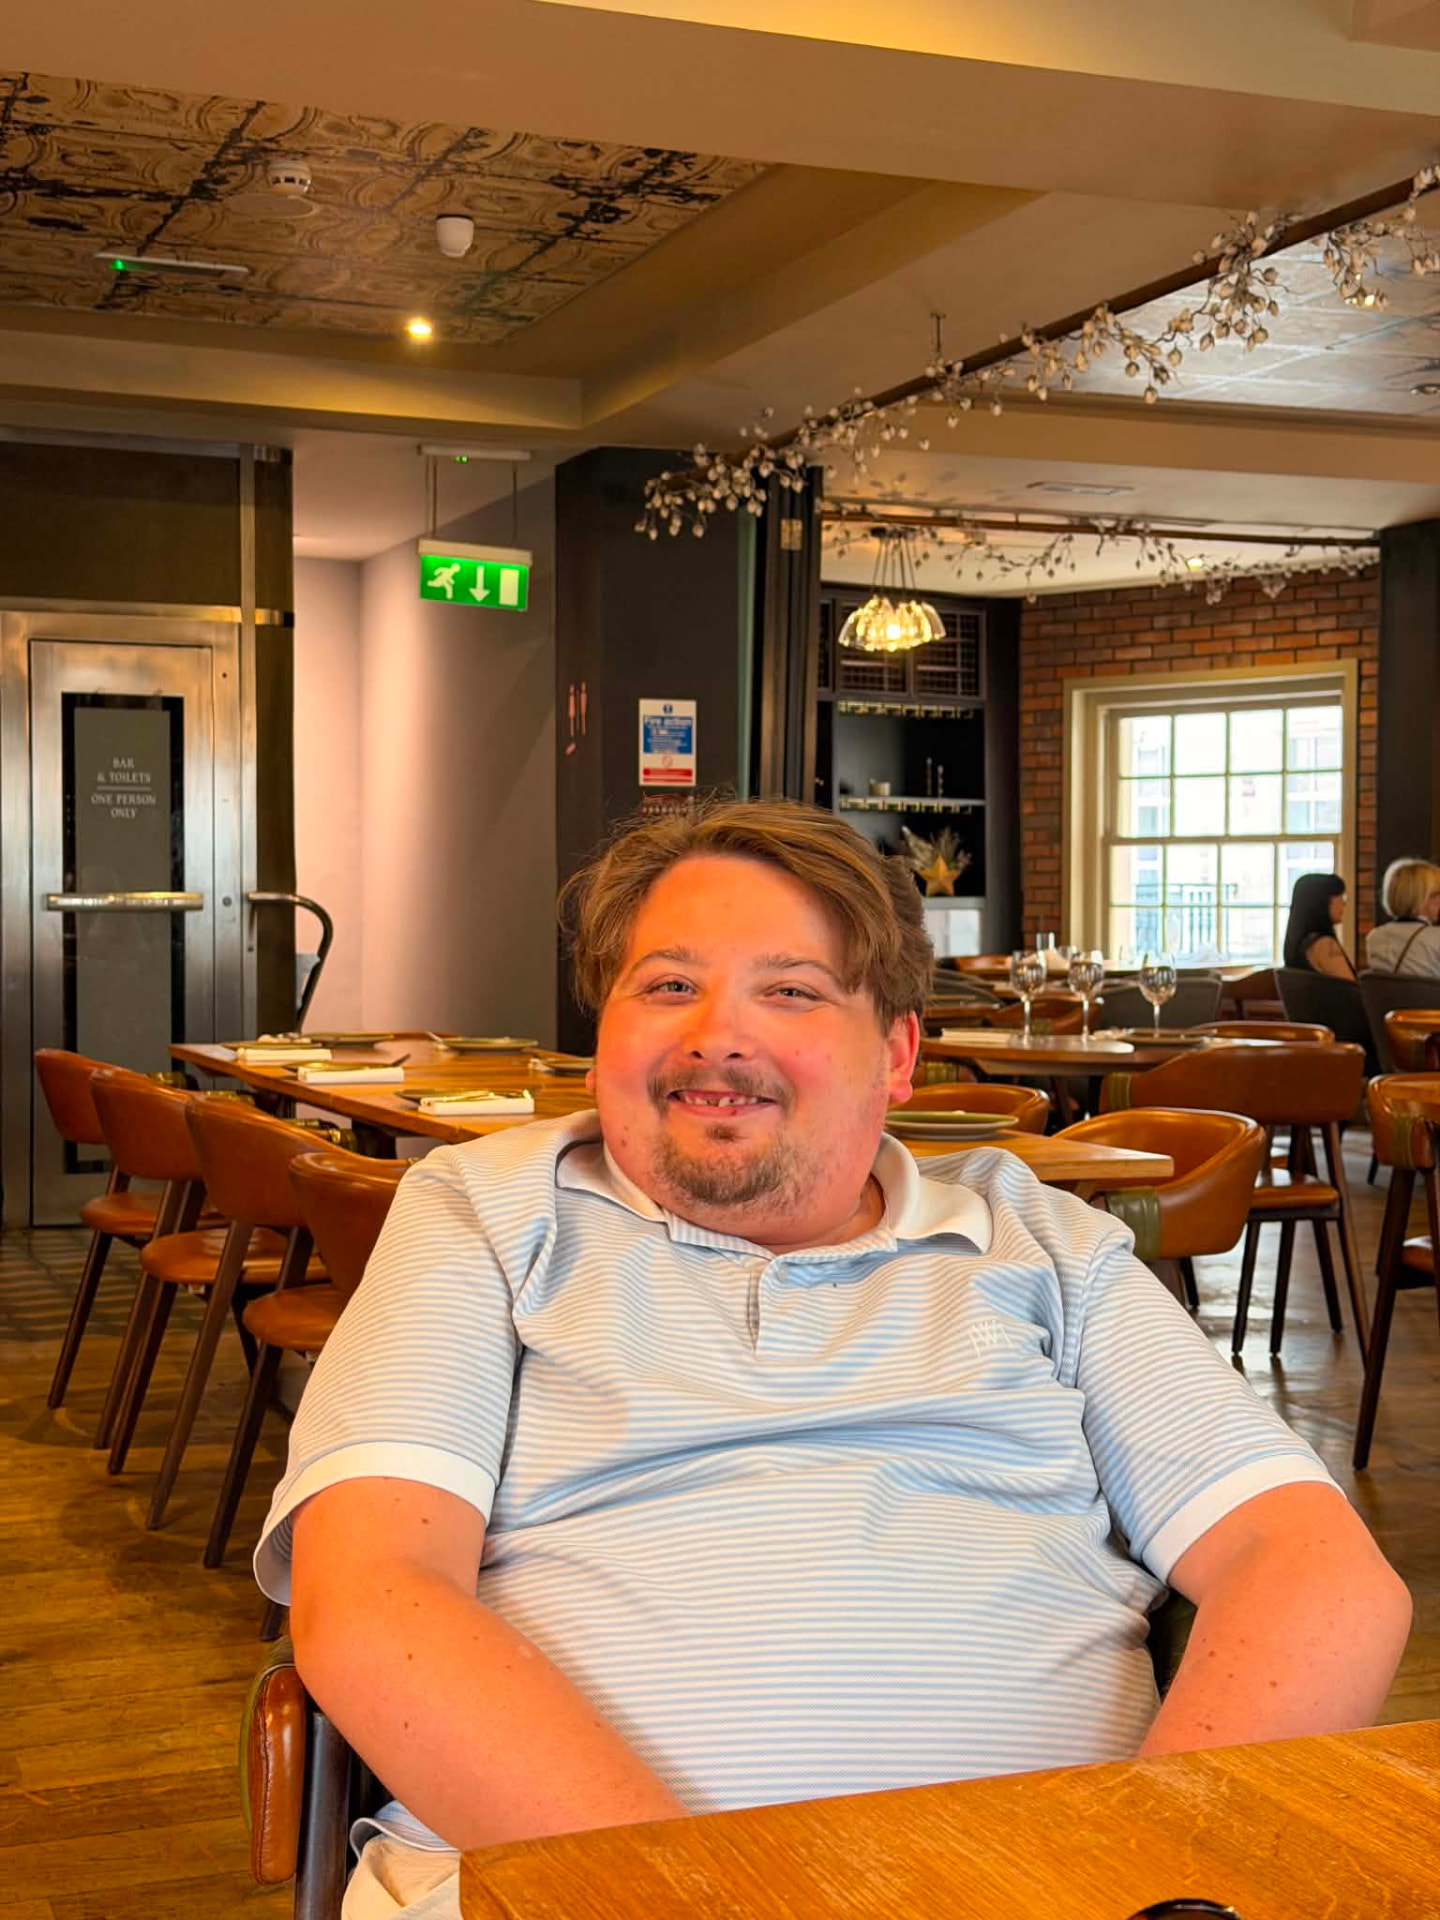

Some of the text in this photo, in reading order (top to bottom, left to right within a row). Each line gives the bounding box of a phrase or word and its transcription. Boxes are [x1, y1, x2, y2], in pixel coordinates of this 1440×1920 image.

[113, 758, 134, 769] BAR
[109, 772, 151, 784] TOILETS
[91, 793, 156, 806] ONE PERSON
[111, 807, 137, 818] ONLY
